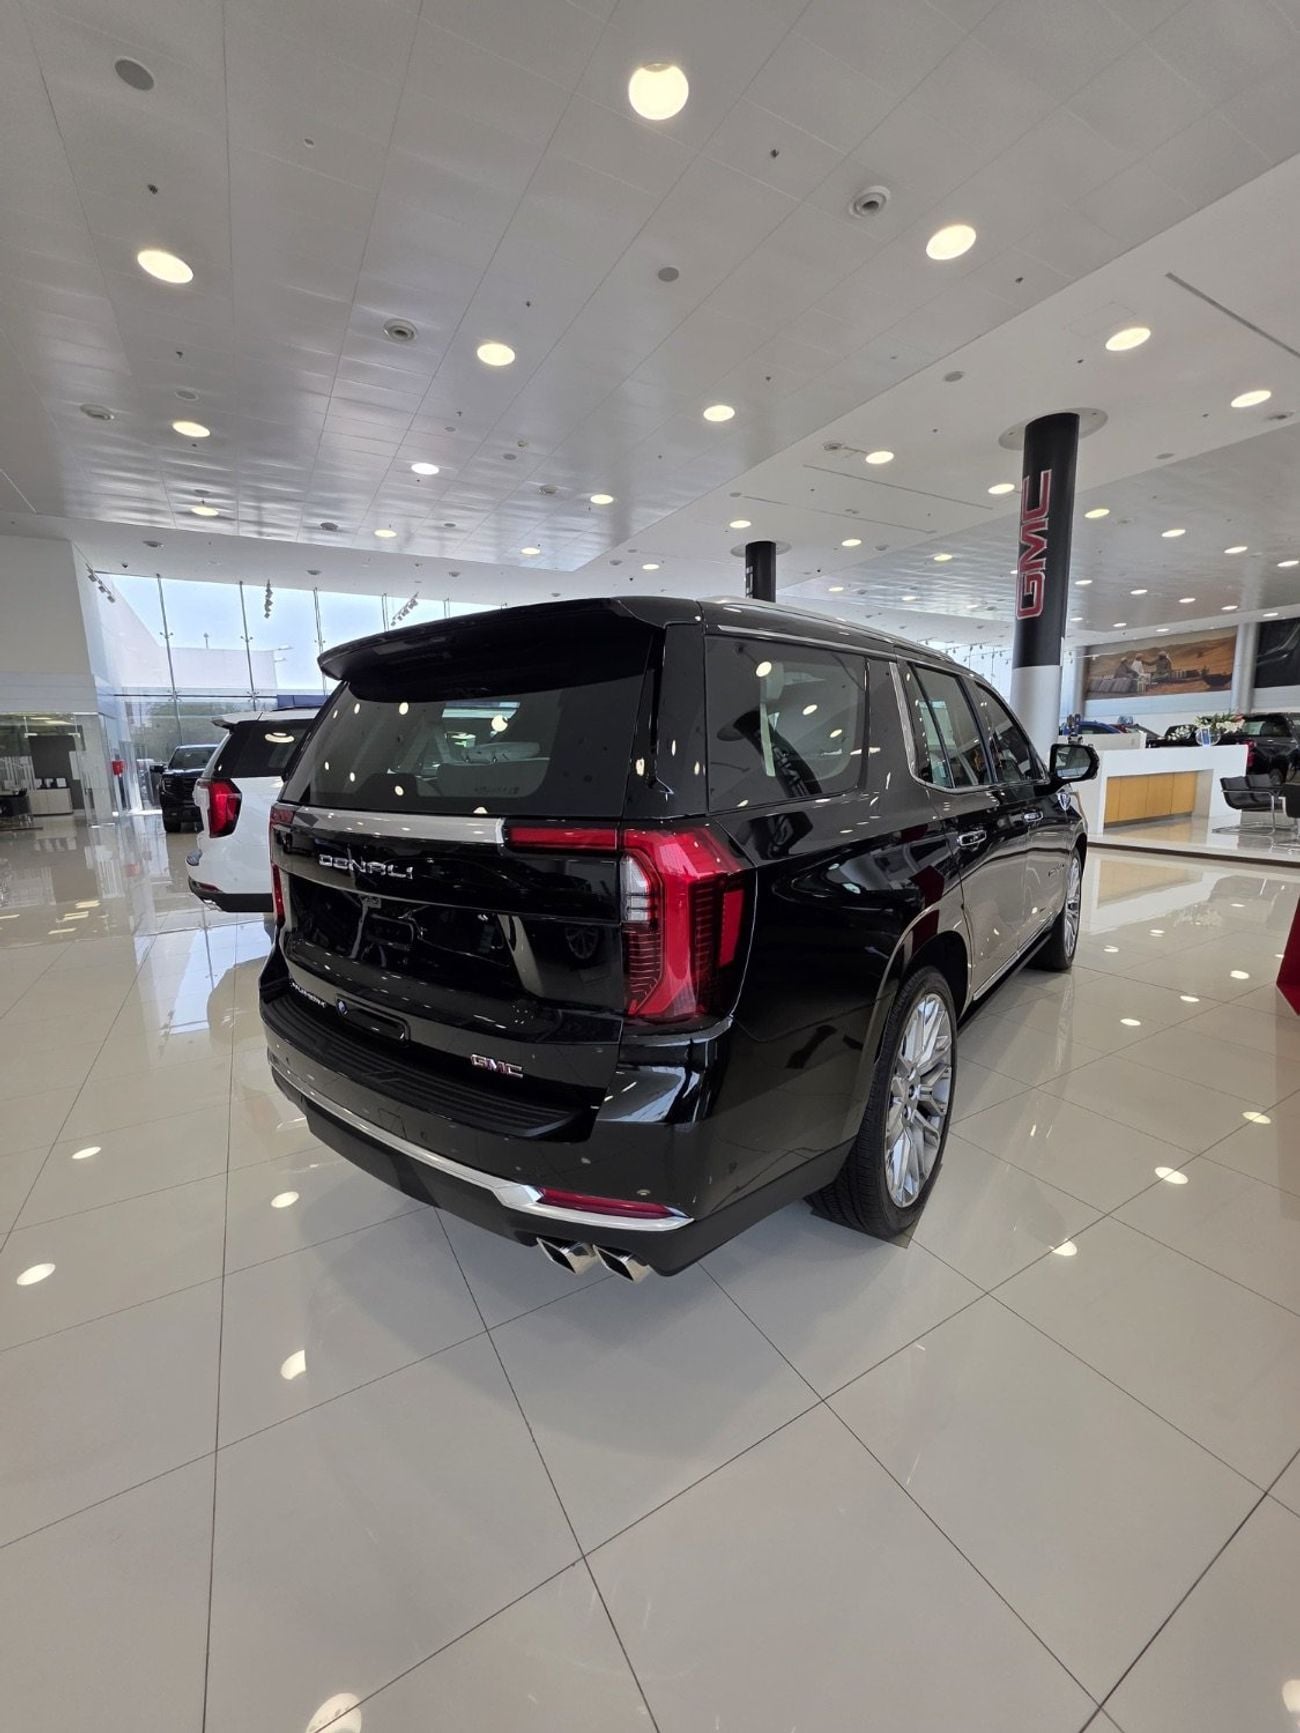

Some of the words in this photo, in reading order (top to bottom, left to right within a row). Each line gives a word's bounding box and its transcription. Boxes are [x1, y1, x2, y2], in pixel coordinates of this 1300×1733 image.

[1015, 469, 1052, 620] GMC
[319, 853, 413, 880] DENALI
[471, 1053, 523, 1078] GMC
